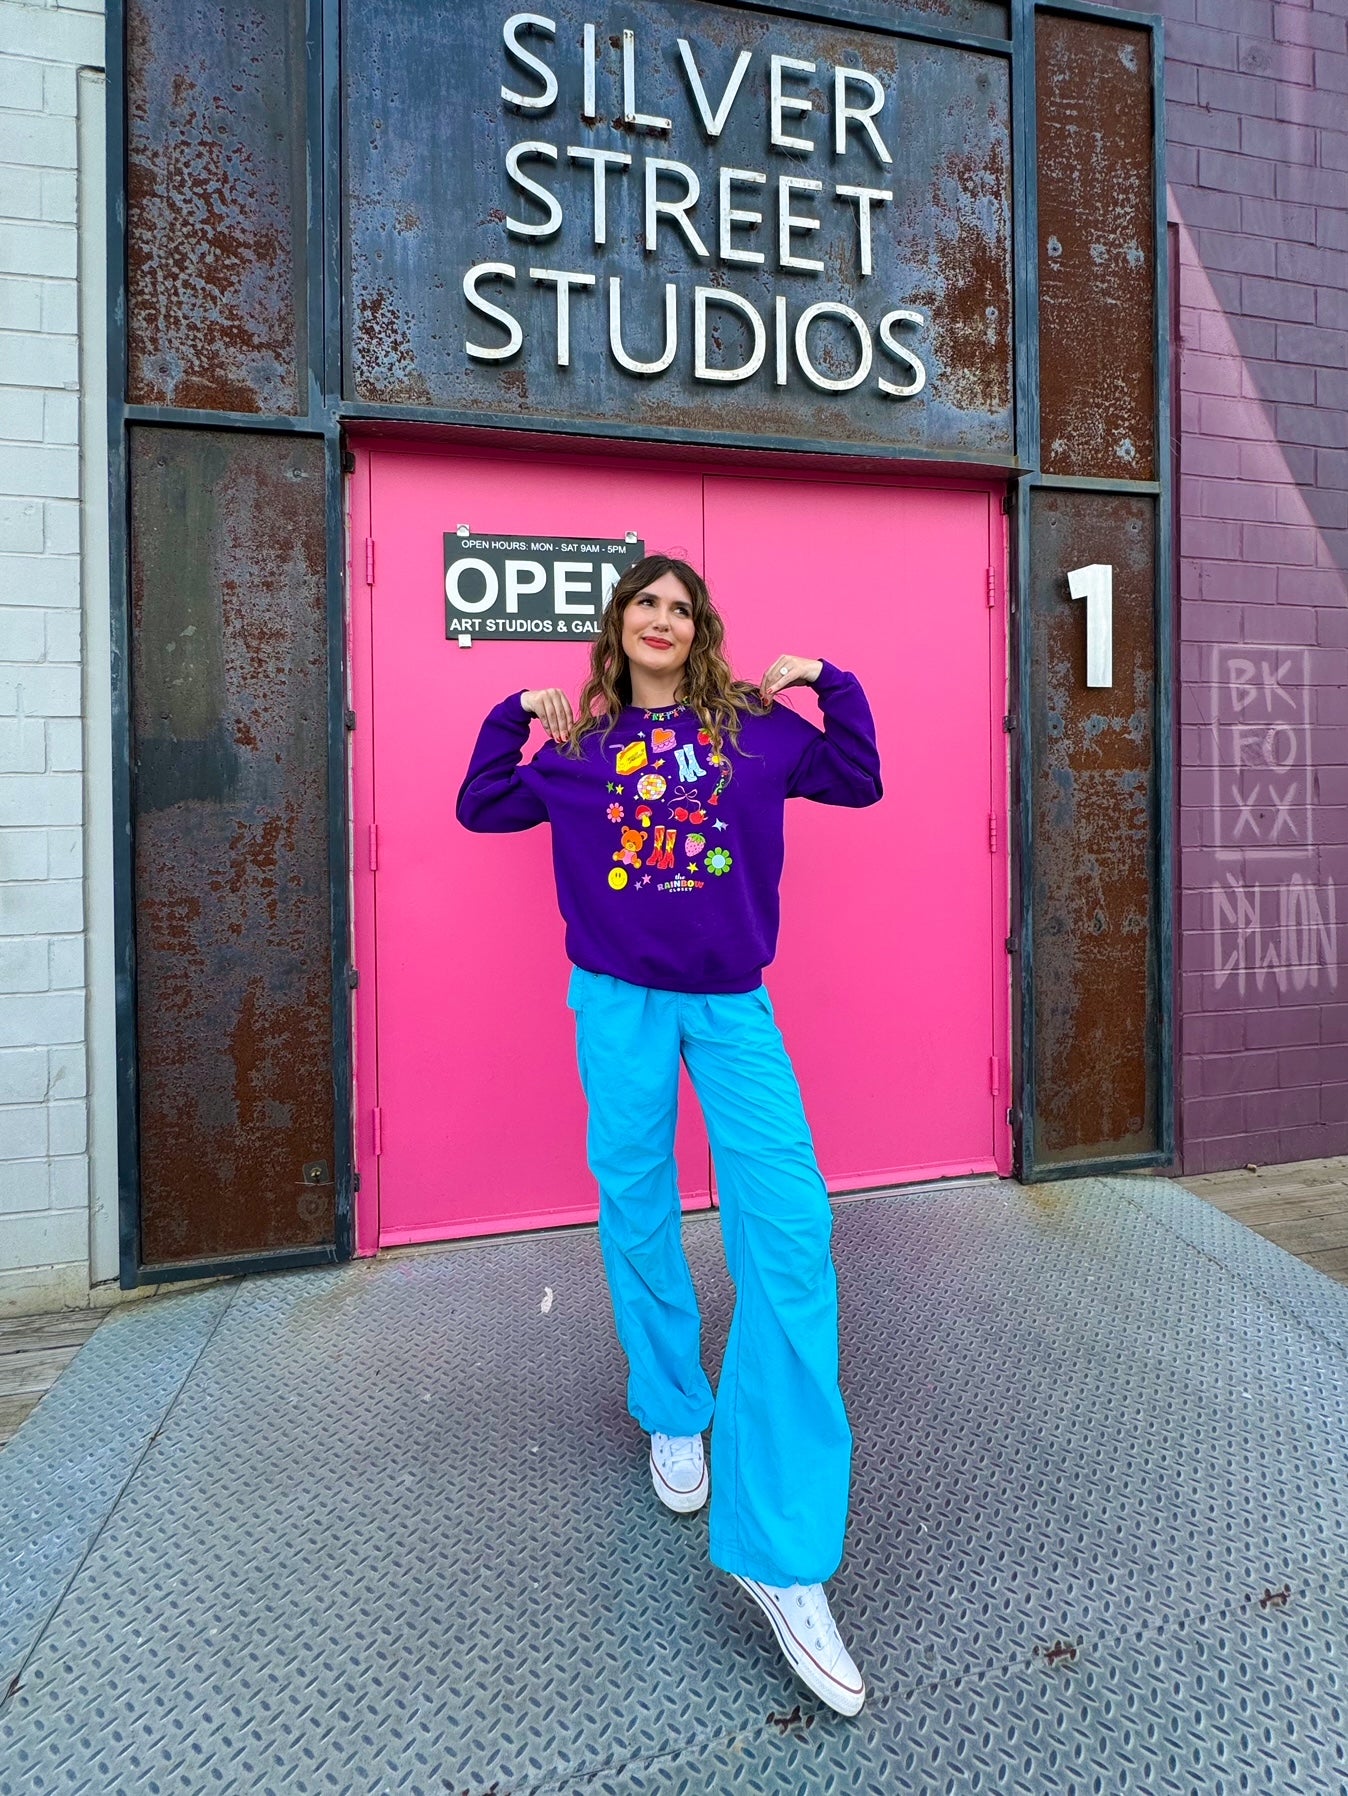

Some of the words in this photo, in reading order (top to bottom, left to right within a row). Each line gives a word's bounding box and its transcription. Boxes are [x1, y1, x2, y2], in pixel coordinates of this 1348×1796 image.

[501, 12, 893, 164] SILVER
[505, 141, 893, 276] STREET
[462, 262, 926, 397] STUDIOS
[461, 539, 490, 549] OPEN
[491, 541, 529, 550] HOURS:
[531, 543, 553, 551] MON
[561, 543, 578, 552] SAT
[580, 544, 600, 552] 9AM
[607, 545, 627, 554] 5PM
[450, 619, 482, 631] ART
[486, 619, 553, 632] STUDIOS
[557, 621, 568, 632] &
[1067, 564, 1113, 688] 1
[1232, 781, 1299, 841] XX
[657, 880, 704, 891] RAINBOW
